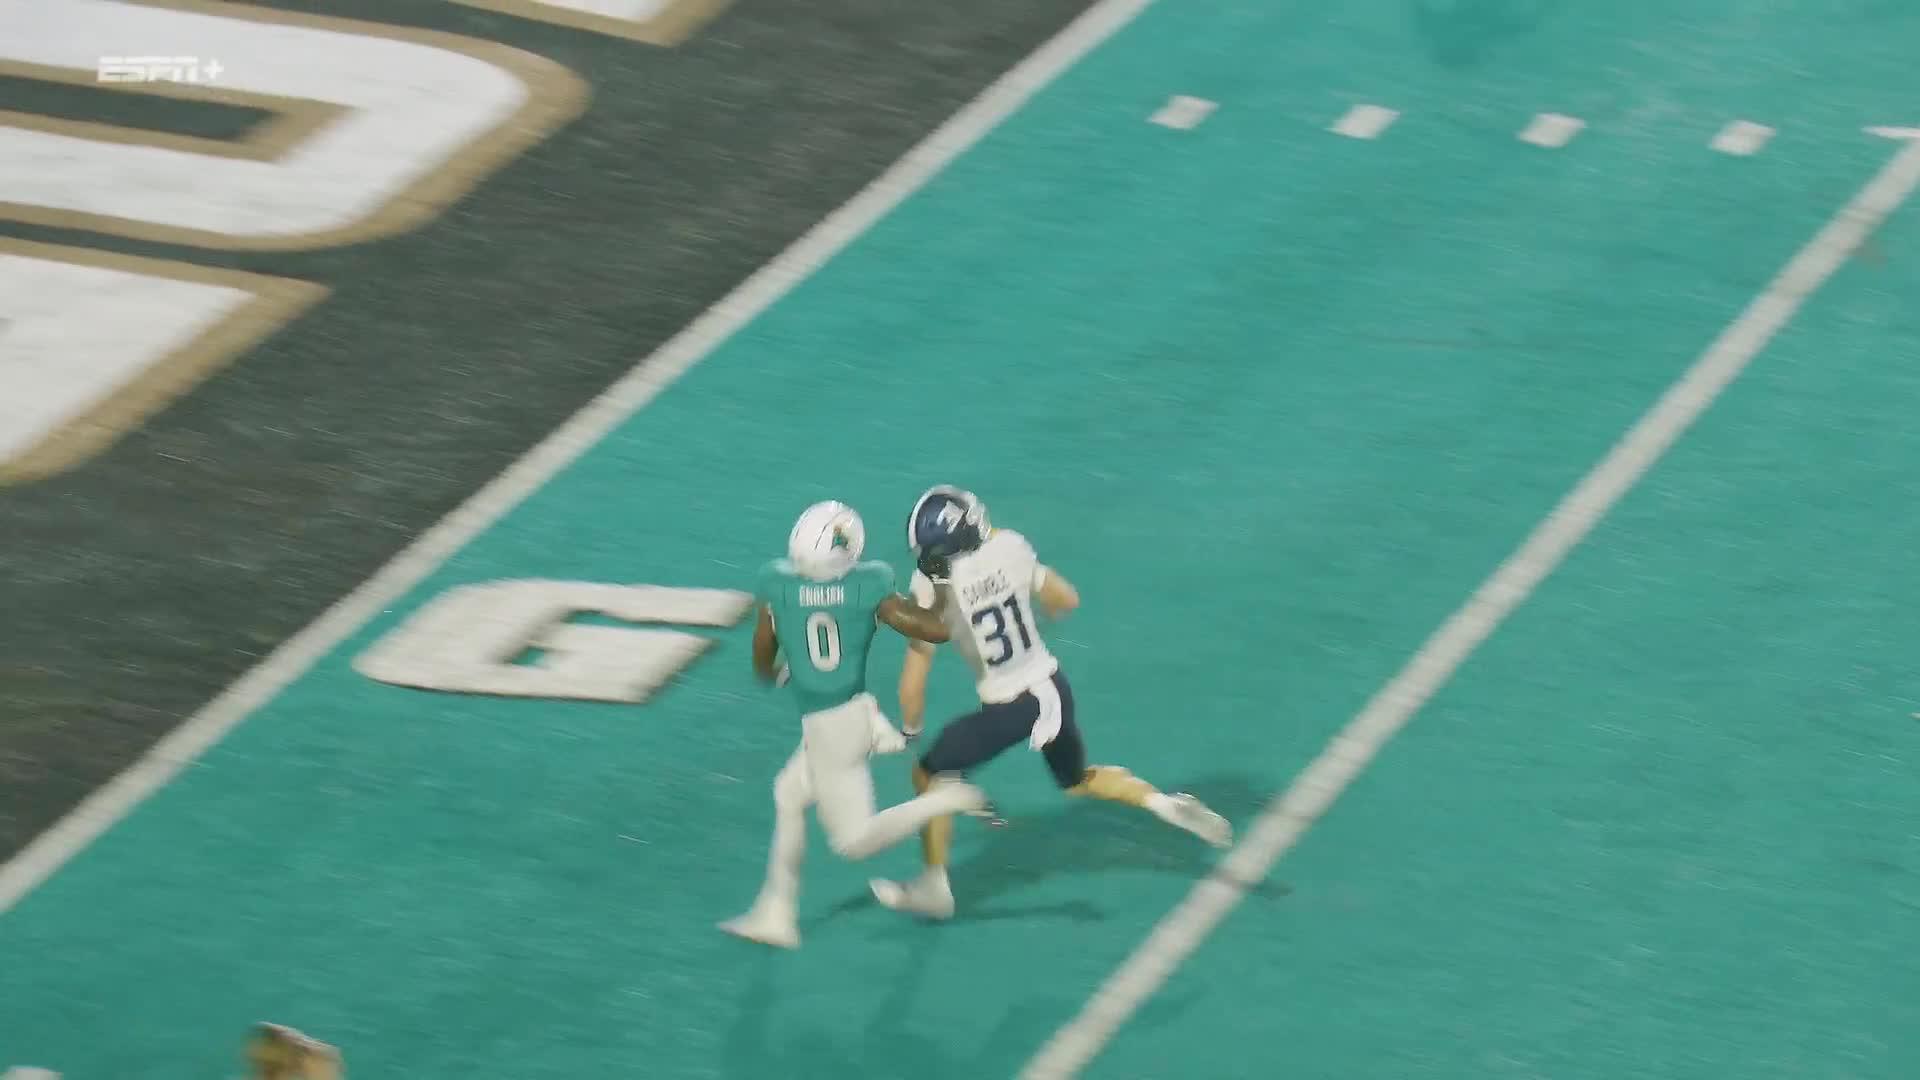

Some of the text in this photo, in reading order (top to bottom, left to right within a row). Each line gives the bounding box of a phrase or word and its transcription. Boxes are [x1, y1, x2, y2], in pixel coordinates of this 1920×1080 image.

[354, 579, 754, 704] G
[806, 611, 841, 672] 0
[971, 592, 1031, 666] 31
